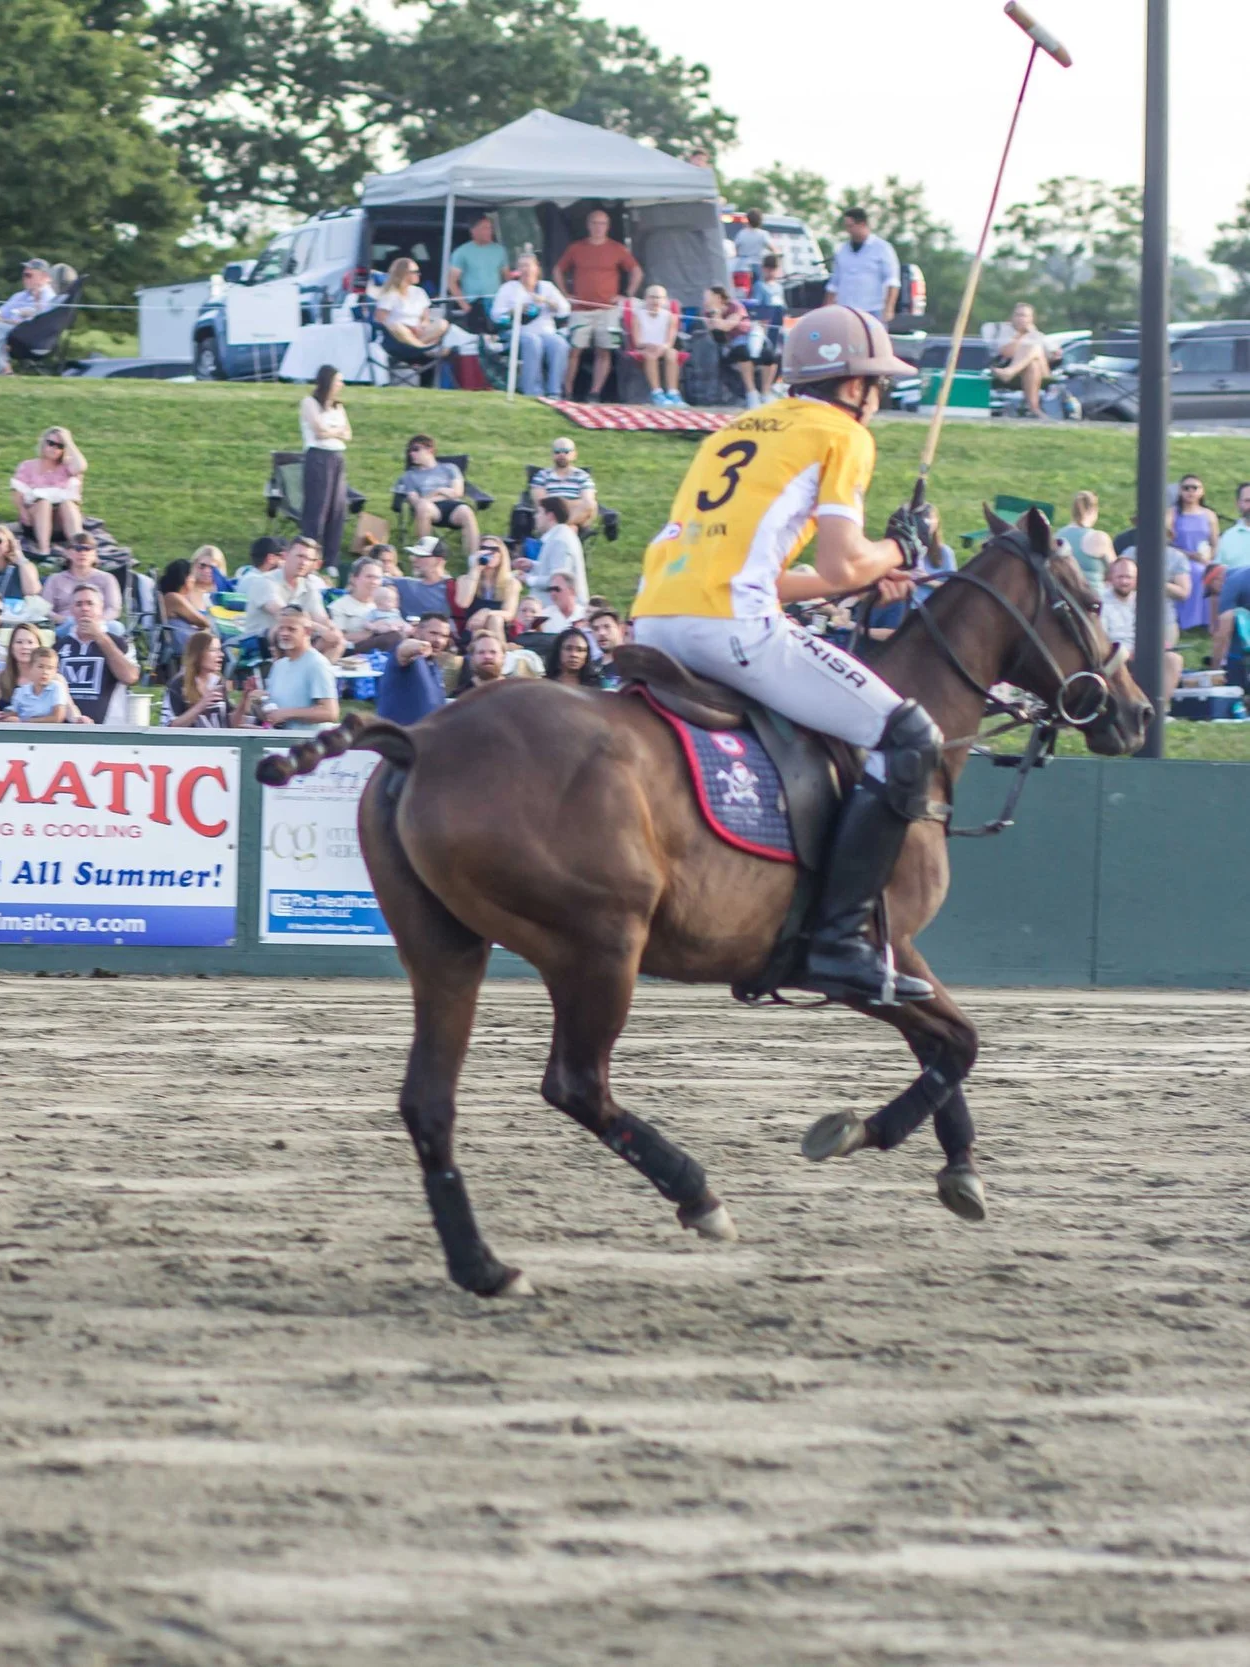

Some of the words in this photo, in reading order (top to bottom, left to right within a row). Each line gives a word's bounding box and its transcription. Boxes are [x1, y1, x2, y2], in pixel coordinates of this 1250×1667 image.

[696, 440, 758, 512] 3
[58, 643, 72, 657] 4
[24, 823, 36, 837] &
[43, 823, 143, 838] COOLING
[12, 860, 61, 886] All
[74, 861, 223, 889] Summer!
